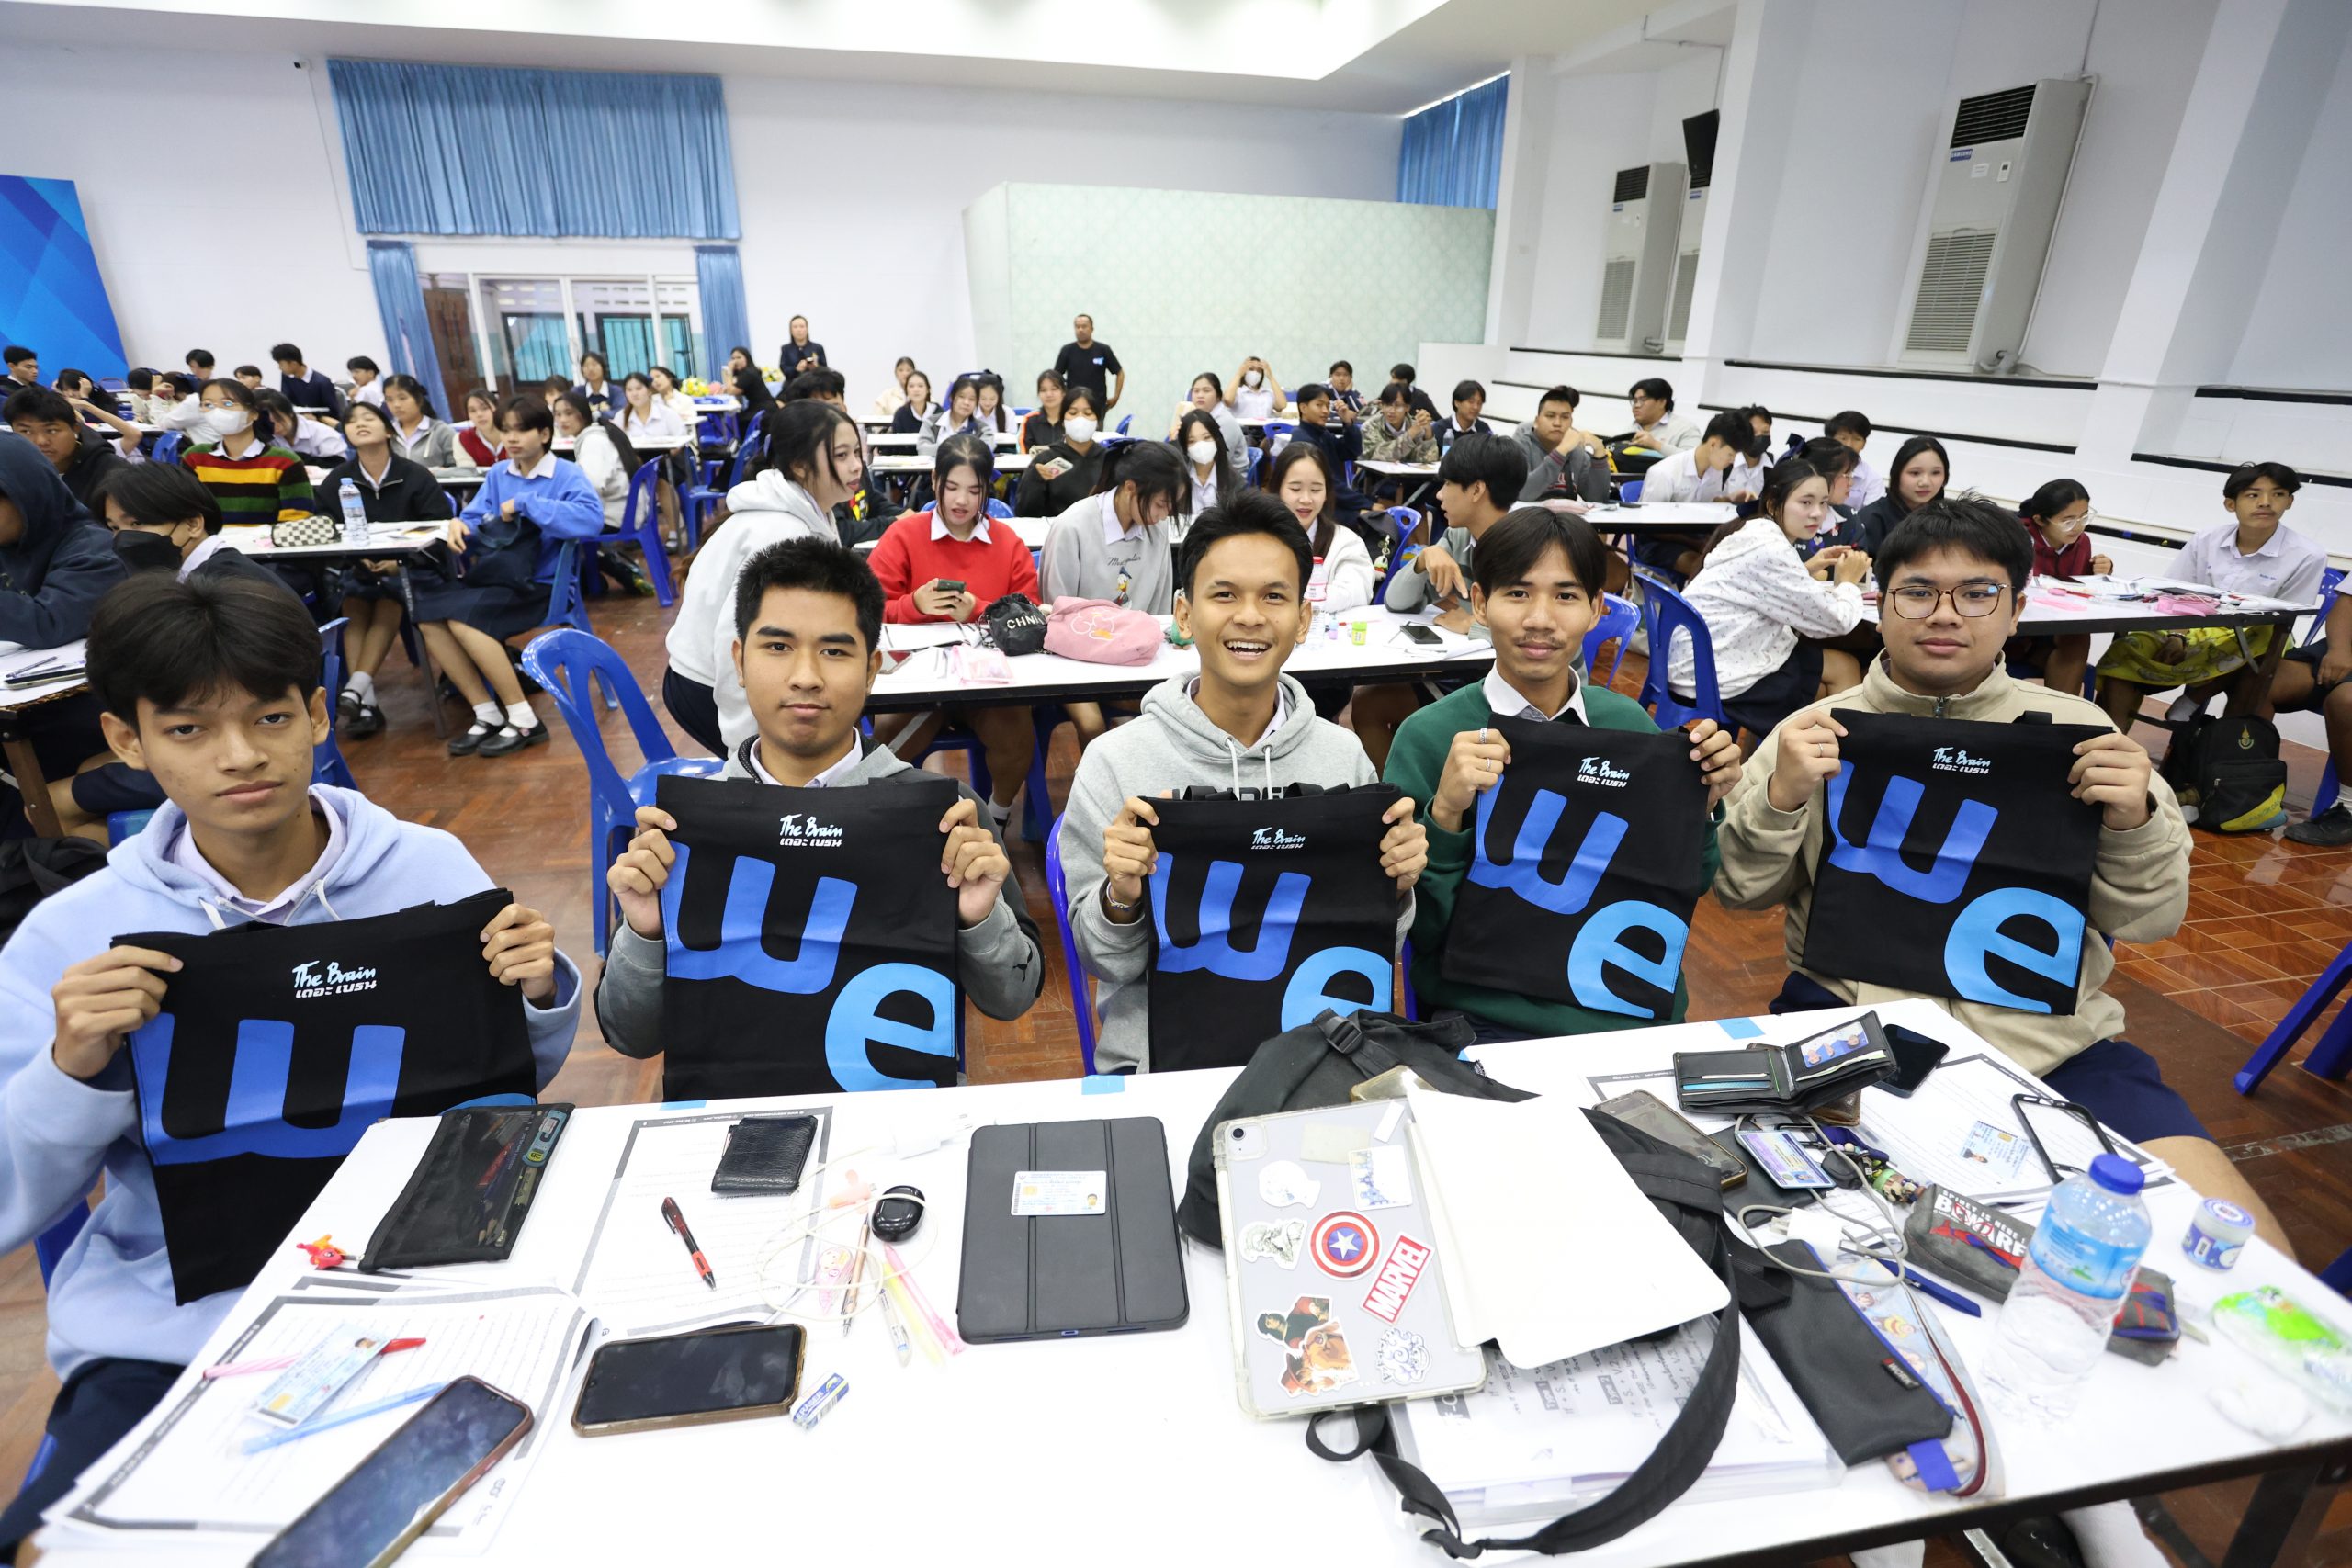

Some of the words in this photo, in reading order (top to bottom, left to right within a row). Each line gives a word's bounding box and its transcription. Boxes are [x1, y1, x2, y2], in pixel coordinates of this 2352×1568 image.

[1579, 757, 1600, 774] The
[1599, 760, 1630, 780] Brain
[1932, 747, 1954, 763] The
[1955, 750, 1991, 767] Brain
[779, 813, 802, 837] The
[805, 816, 843, 838] Brain
[1252, 827, 1272, 845] The
[1273, 829, 1306, 844] Brain
[292, 960, 323, 988] The
[327, 962, 376, 985] Brain
[1934, 1194, 2027, 1257] BEWARE
[1364, 1241, 1428, 1322] MARVEL
